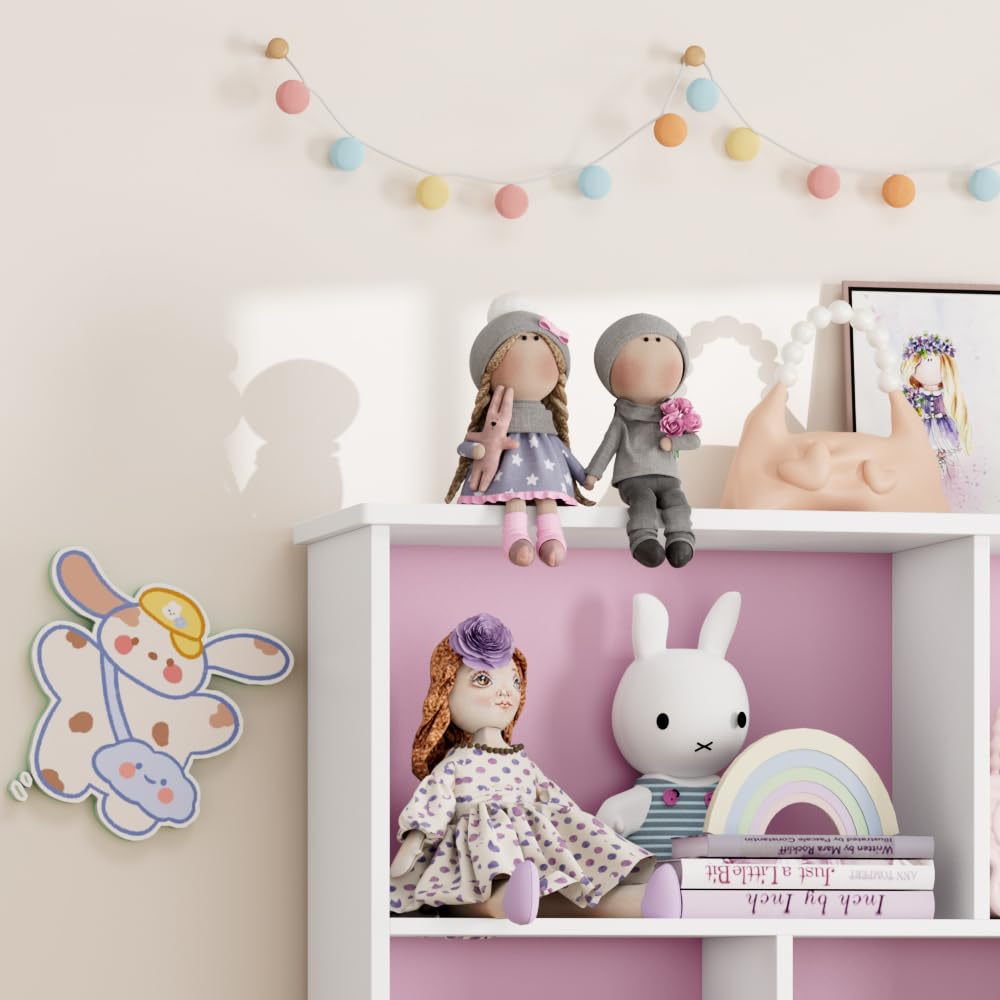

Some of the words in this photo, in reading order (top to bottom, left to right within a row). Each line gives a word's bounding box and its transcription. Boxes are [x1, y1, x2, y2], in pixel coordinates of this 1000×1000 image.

[777, 846, 814, 855] Rockliff
[817, 846, 841, 854] Mara
[843, 843, 854, 855] by
[858, 846, 893, 854] Written
[782, 866, 791, 879] a
[799, 866, 835, 886] Just
[746, 893, 792, 914] Inch
[805, 890, 827, 915] by
[839, 894, 885, 915] Inch
